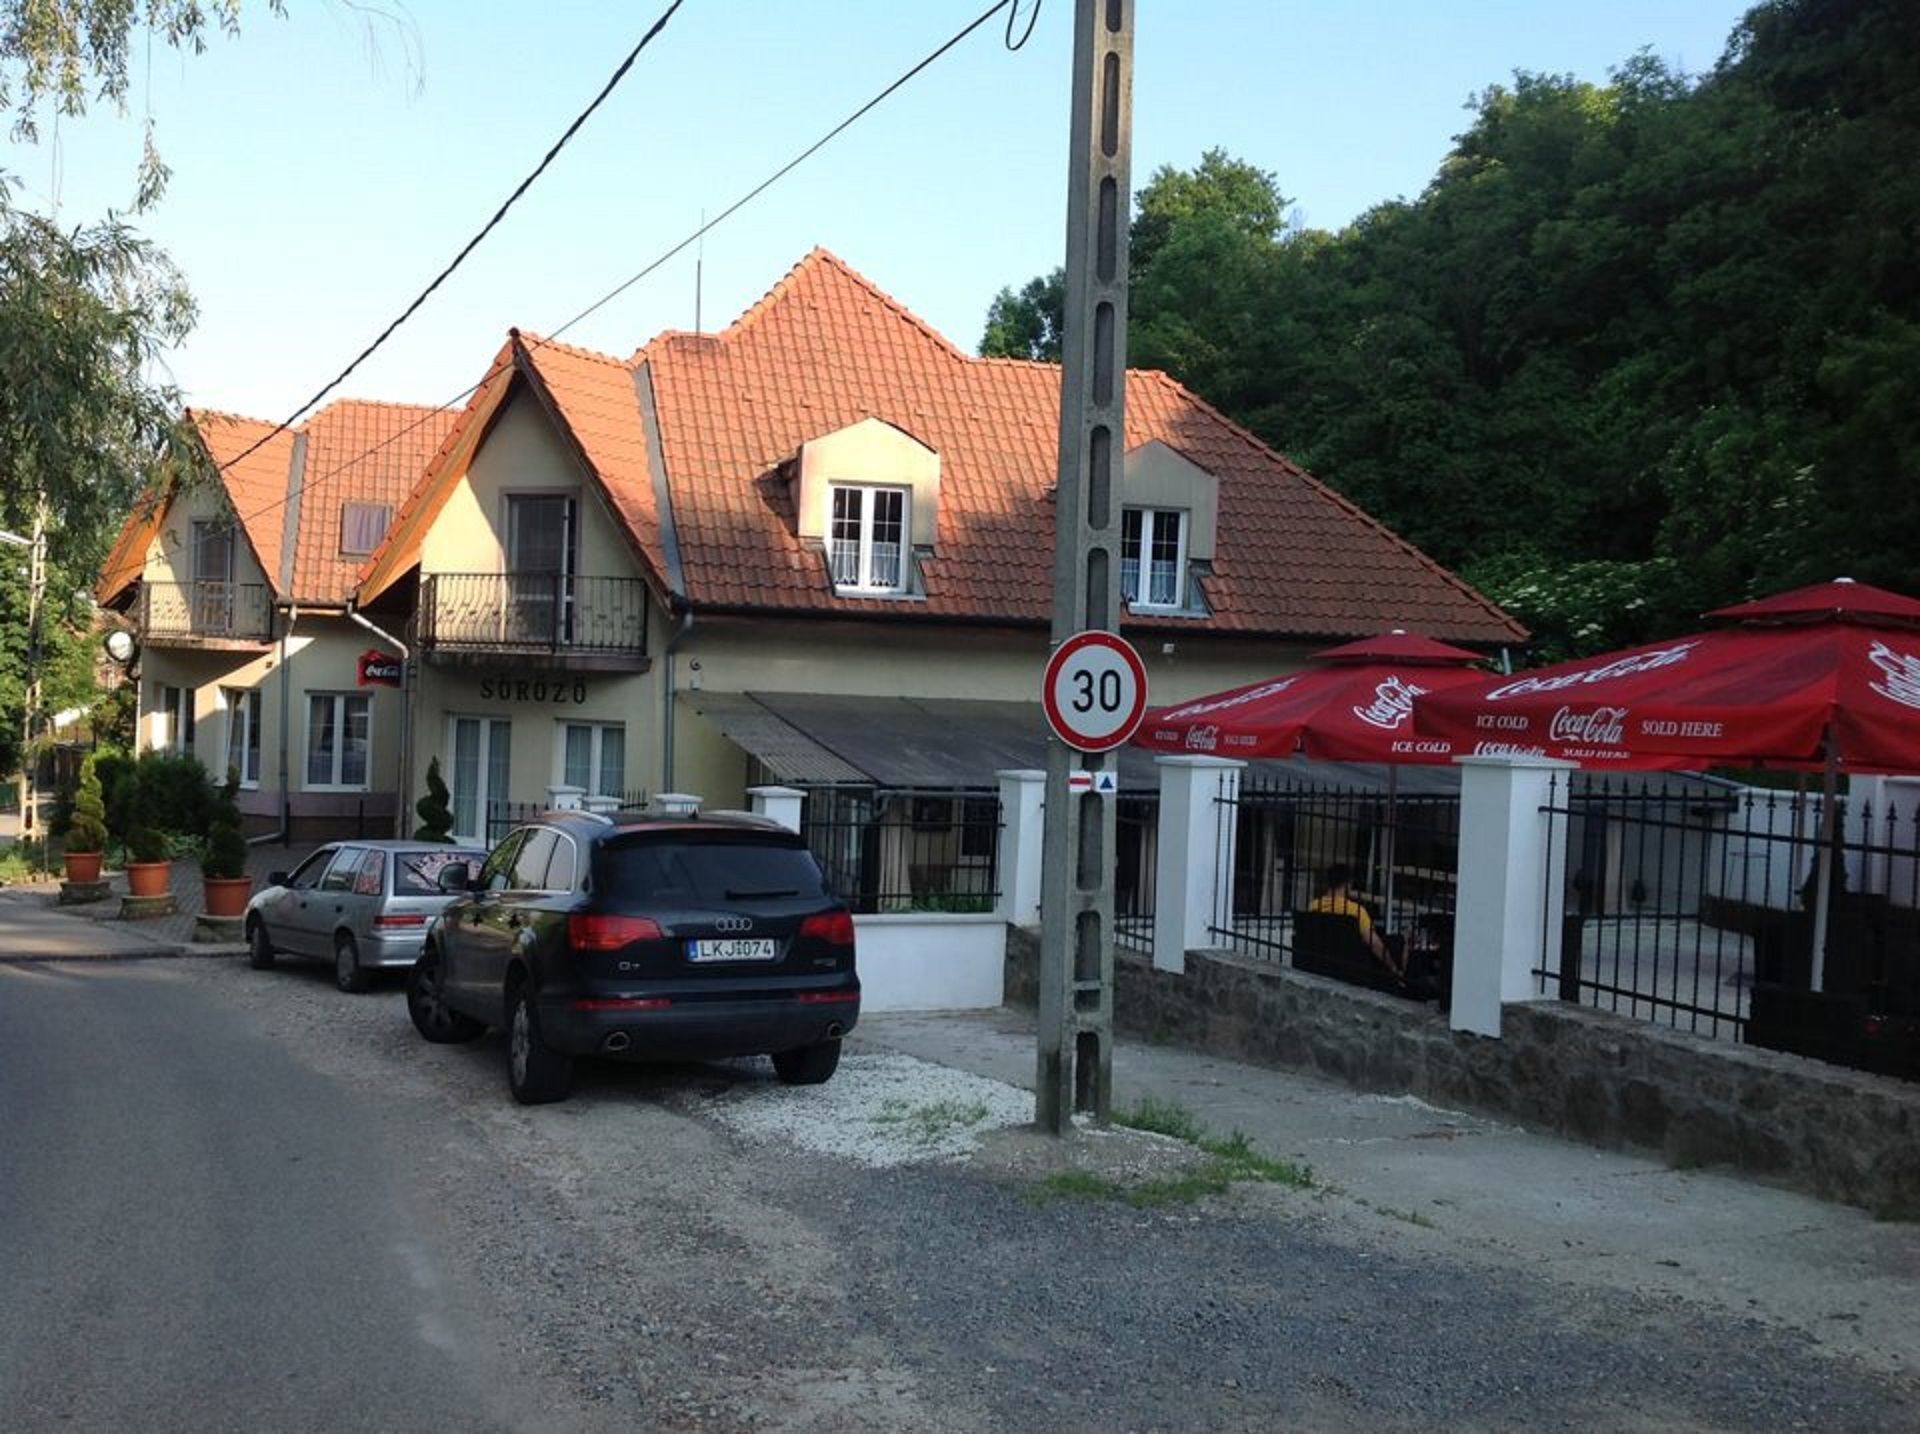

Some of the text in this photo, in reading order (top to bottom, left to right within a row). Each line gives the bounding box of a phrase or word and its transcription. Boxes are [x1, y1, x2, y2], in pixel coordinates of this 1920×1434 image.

[1072, 669, 1121, 713] 30
[1476, 714, 1529, 729] ICE COLD
[1641, 720, 1723, 737] SOLD HERE
[1391, 741, 1451, 753] ICE COLD
